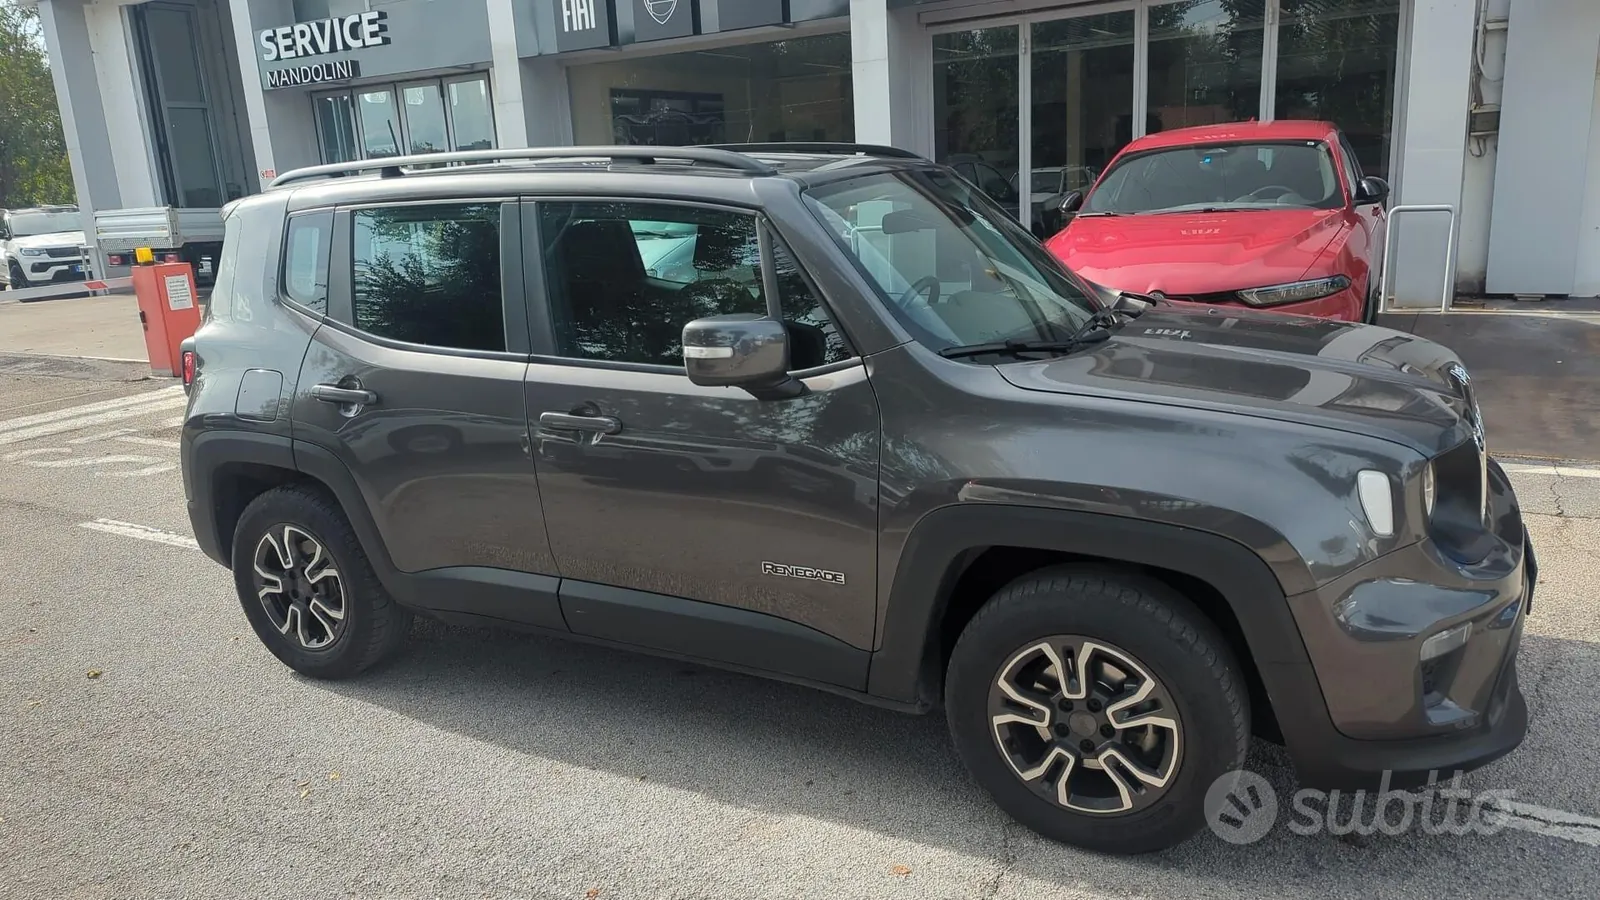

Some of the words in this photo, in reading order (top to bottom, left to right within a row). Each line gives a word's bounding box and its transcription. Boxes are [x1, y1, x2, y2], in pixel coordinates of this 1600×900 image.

[260, 11, 385, 61] SERVICE
[266, 60, 354, 88] MANDOLINI
[761, 561, 845, 585] RENEGADE
